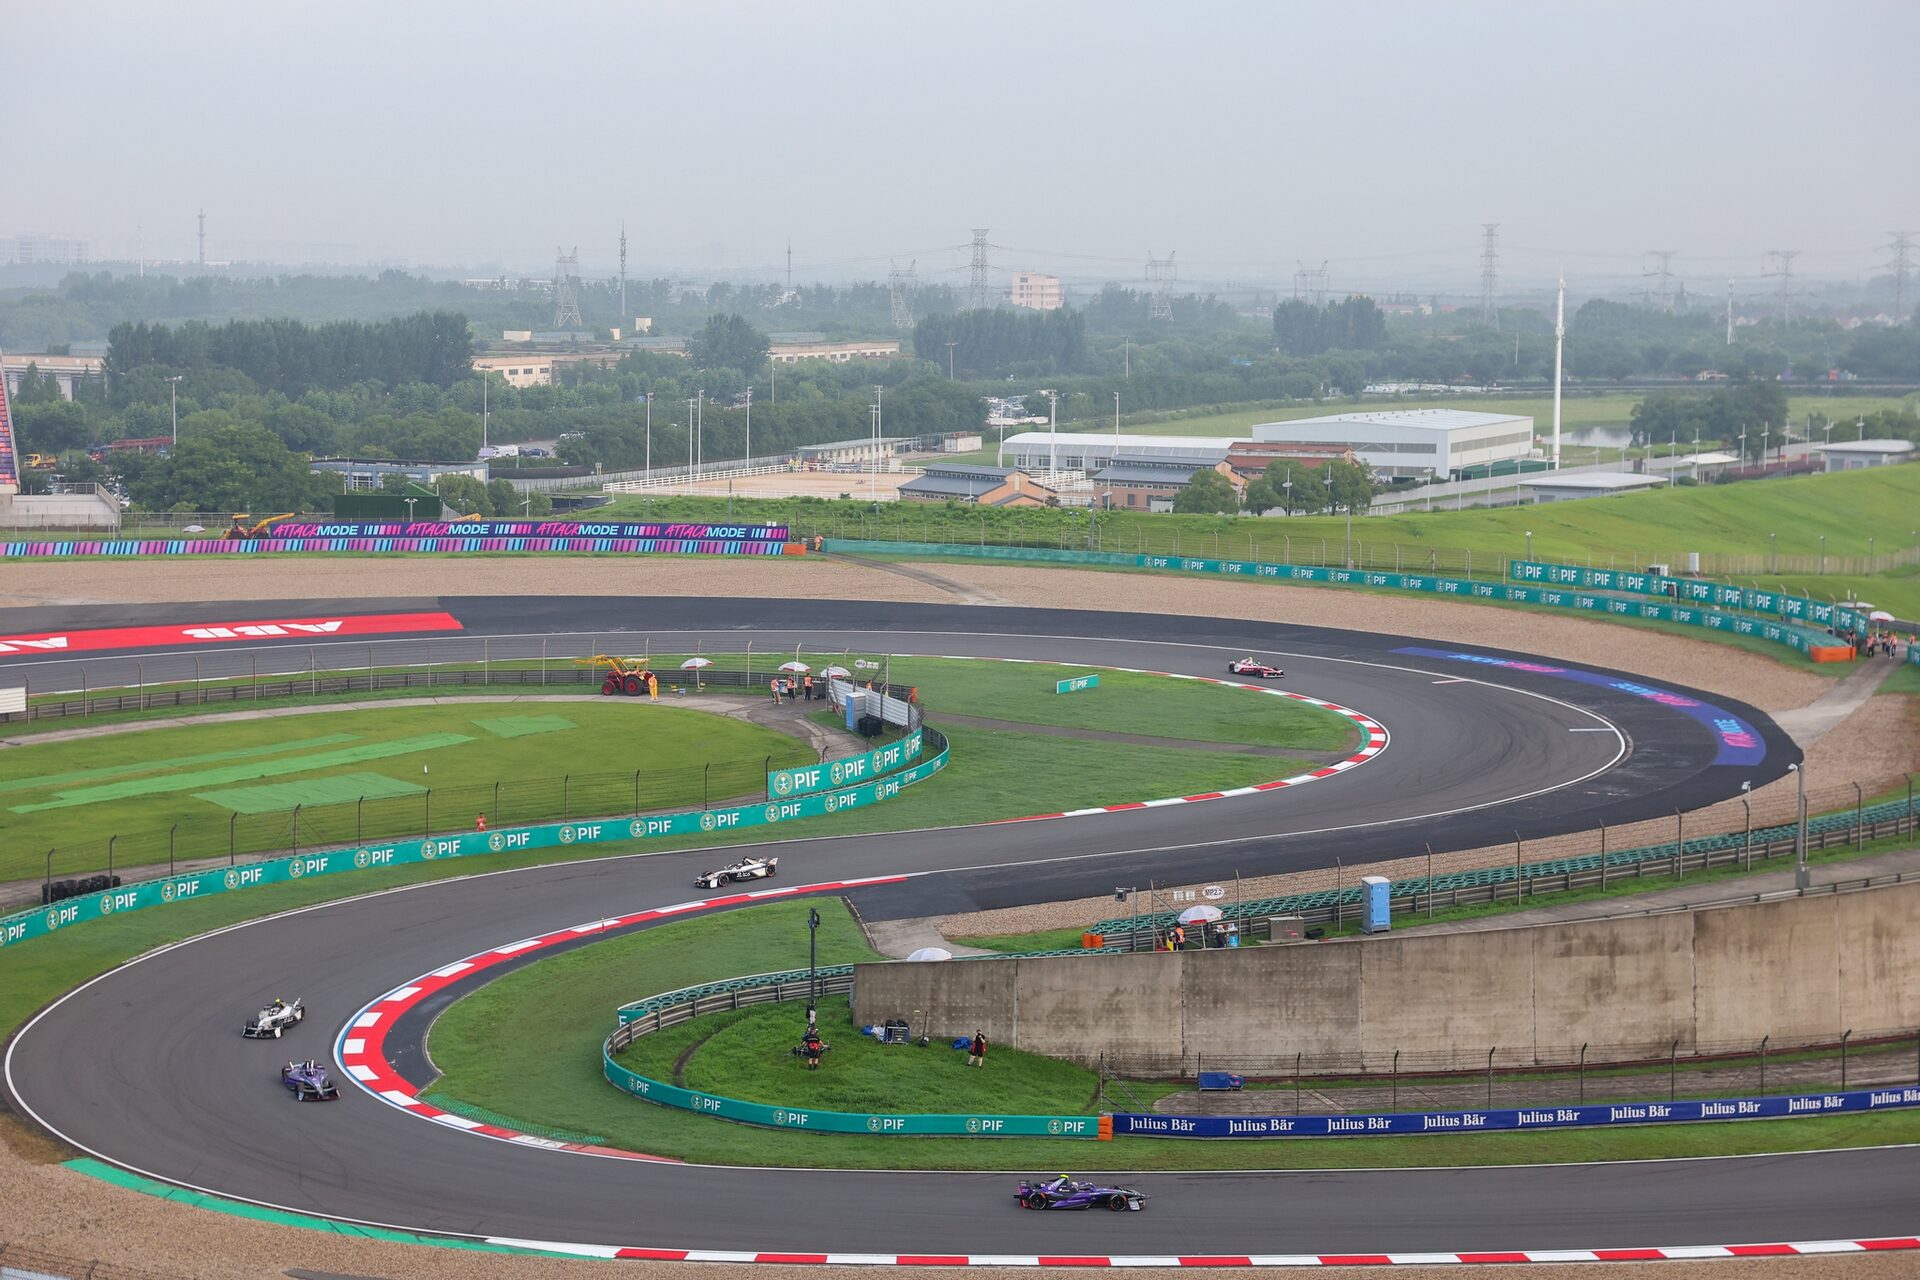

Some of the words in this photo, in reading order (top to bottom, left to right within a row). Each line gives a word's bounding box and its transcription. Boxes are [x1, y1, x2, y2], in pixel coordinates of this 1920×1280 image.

[1154, 558, 1167, 567] PIF
[1191, 561, 1204, 570] PIF
[1229, 563, 1241, 573] PIF
[1265, 566, 1277, 576] PIF
[1301, 569, 1313, 579] PIF
[1338, 572, 1350, 582] PIF
[1525, 565, 1542, 579] PIF
[1560, 569, 1577, 582] PIF
[1374, 575, 1386, 585] PIF
[1410, 579, 1422, 588] PIF
[1594, 572, 1610, 586] PIF
[1628, 576, 1644, 590] PIF
[1445, 583, 1458, 592] PIF
[1480, 586, 1492, 596] PIF
[1693, 585, 1708, 598] PIF
[1515, 590, 1526, 600] PIF
[1549, 594, 1561, 604] PIF
[1725, 590, 1740, 603] PIF
[1757, 595, 1771, 608] PIF
[1582, 597, 1594, 608] PIF
[1615, 602, 1627, 613] PIF
[1787, 600, 1801, 614] PIF
[1648, 606, 1659, 617] PIF
[1680, 611, 1691, 621] PIF
[1816, 606, 1829, 620] PIF
[1078, 680, 1087, 688] PIF
[883, 747, 900, 766] PIF
[845, 759, 865, 778] PIF
[794, 770, 820, 789] PIF
[886, 782, 899, 795] PIF
[839, 793, 857, 808] PIF
[781, 804, 801, 818] PIF
[648, 820, 672, 834] PIF
[717, 813, 740, 827] PIF
[507, 833, 530, 847] PIF
[577, 826, 601, 840] PIF
[438, 840, 460, 855] PIF
[372, 849, 394, 864] PIF
[306, 858, 328, 873] PIF
[241, 868, 262, 884] PIF
[177, 881, 199, 896] PIF
[115, 893, 137, 909] PIF
[60, 906, 78, 924] PIF
[8, 923, 26, 941] PIF
[636, 1080, 649, 1094] PIF
[703, 1098, 721, 1111] PIF
[1788, 1097, 1821, 1113] Julius
[1823, 1096, 1845, 1108] Bär
[1870, 1092, 1902, 1106] Julius
[1610, 1107, 1645, 1122] Julius
[1648, 1105, 1671, 1118] Bär
[1701, 1103, 1736, 1118] Julius
[1738, 1101, 1761, 1114] Bär
[788, 1113, 808, 1125] PIF
[883, 1118, 905, 1130] PIF
[1129, 1117, 1166, 1131] Julius
[1171, 1117, 1196, 1131] Bär
[1423, 1115, 1460, 1130] Julius
[1463, 1113, 1487, 1126] Bär
[1518, 1111, 1553, 1126] Julius
[1557, 1109, 1581, 1122] Bär
[982, 1119, 1004, 1132] PIF
[1063, 1121, 1085, 1133] PIF
[1228, 1119, 1266, 1134] Julius
[1270, 1118, 1294, 1131] Bär
[1327, 1118, 1364, 1133] Julius
[1367, 1117, 1392, 1130] Bär
